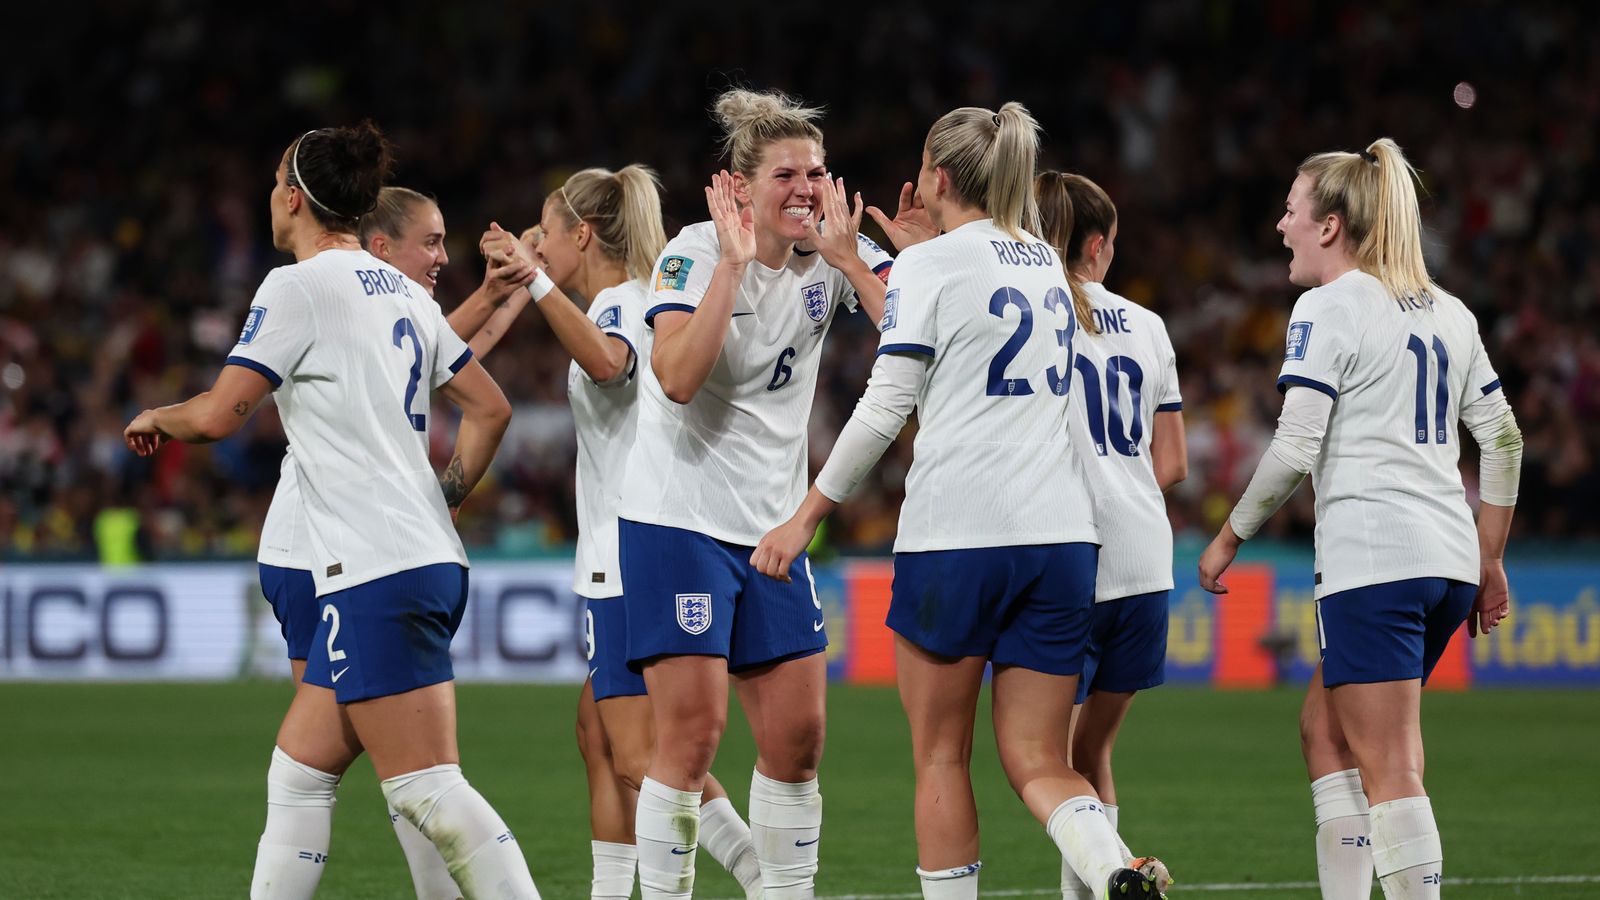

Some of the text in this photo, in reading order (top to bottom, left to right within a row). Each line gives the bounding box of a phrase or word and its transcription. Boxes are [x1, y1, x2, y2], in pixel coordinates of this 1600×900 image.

[990, 240, 1053, 266] RUSSO
[986, 286, 1077, 397] 23
[1077, 308, 1131, 334] ONE
[392, 317, 426, 431] 2
[767, 346, 796, 391] 6
[1074, 353, 1144, 457] 10
[1406, 333, 1450, 444] 11
[322, 604, 347, 662] 2
